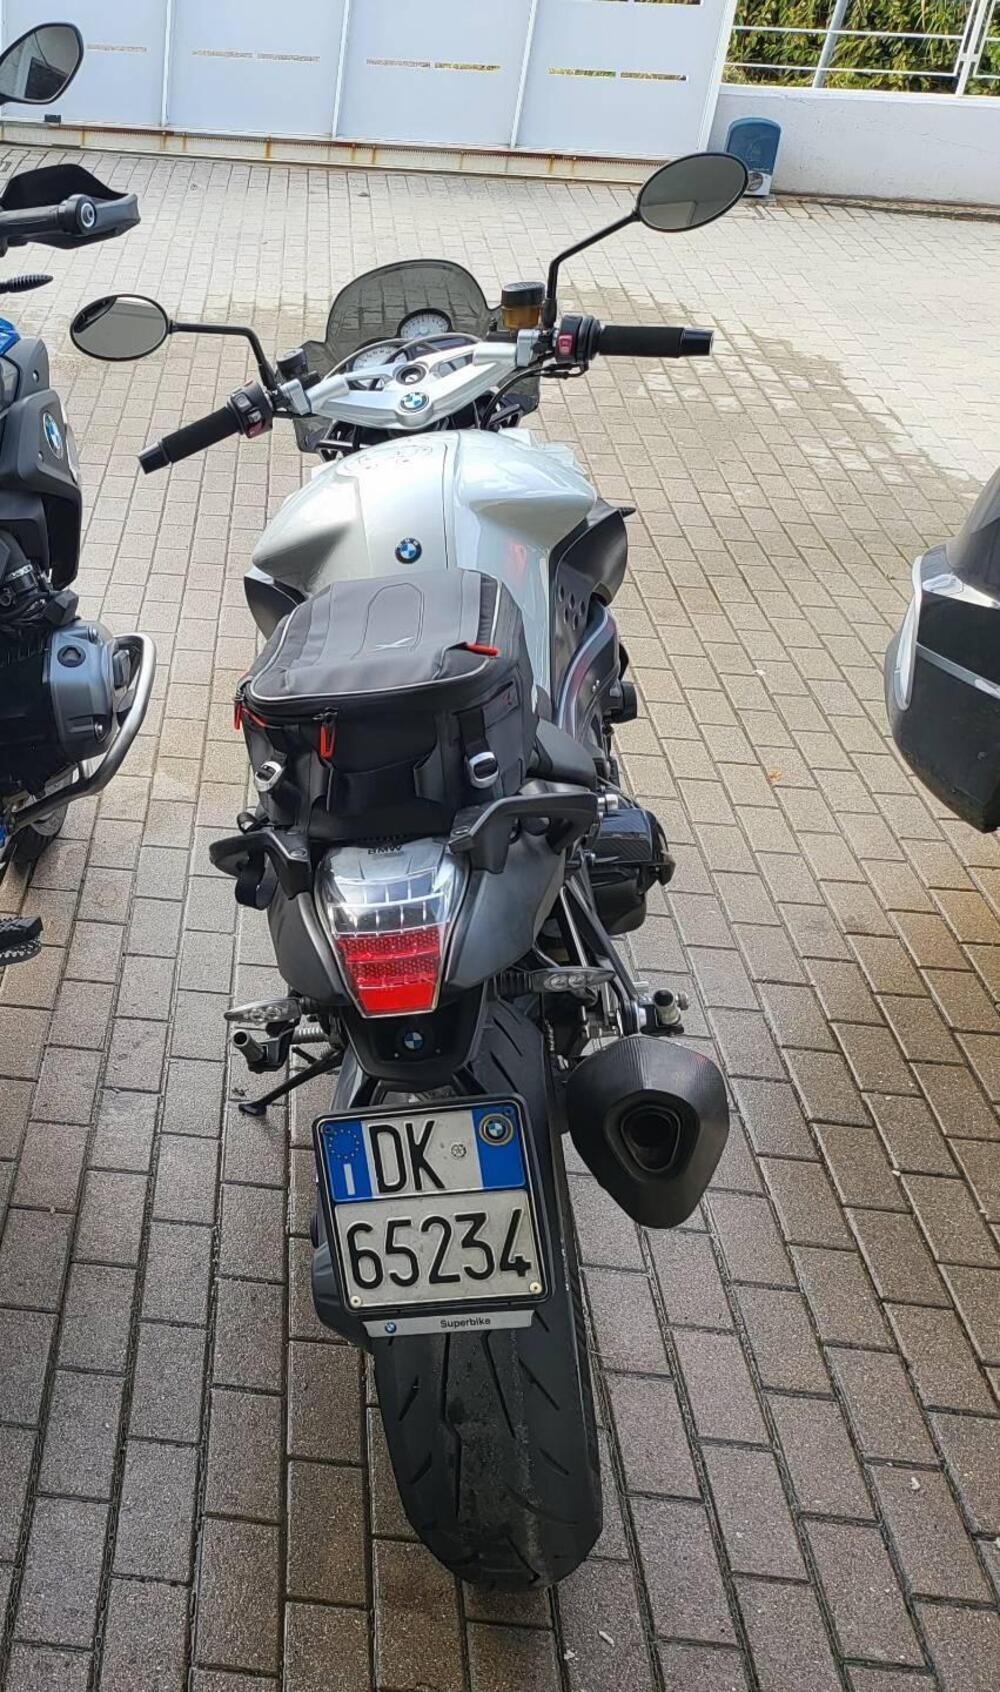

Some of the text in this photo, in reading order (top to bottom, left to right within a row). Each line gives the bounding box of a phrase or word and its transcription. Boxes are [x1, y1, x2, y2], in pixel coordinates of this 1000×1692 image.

[368, 1120, 445, 1193] DK
[346, 1208, 532, 1290] 65234
[440, 1317, 491, 1329] Superbike
